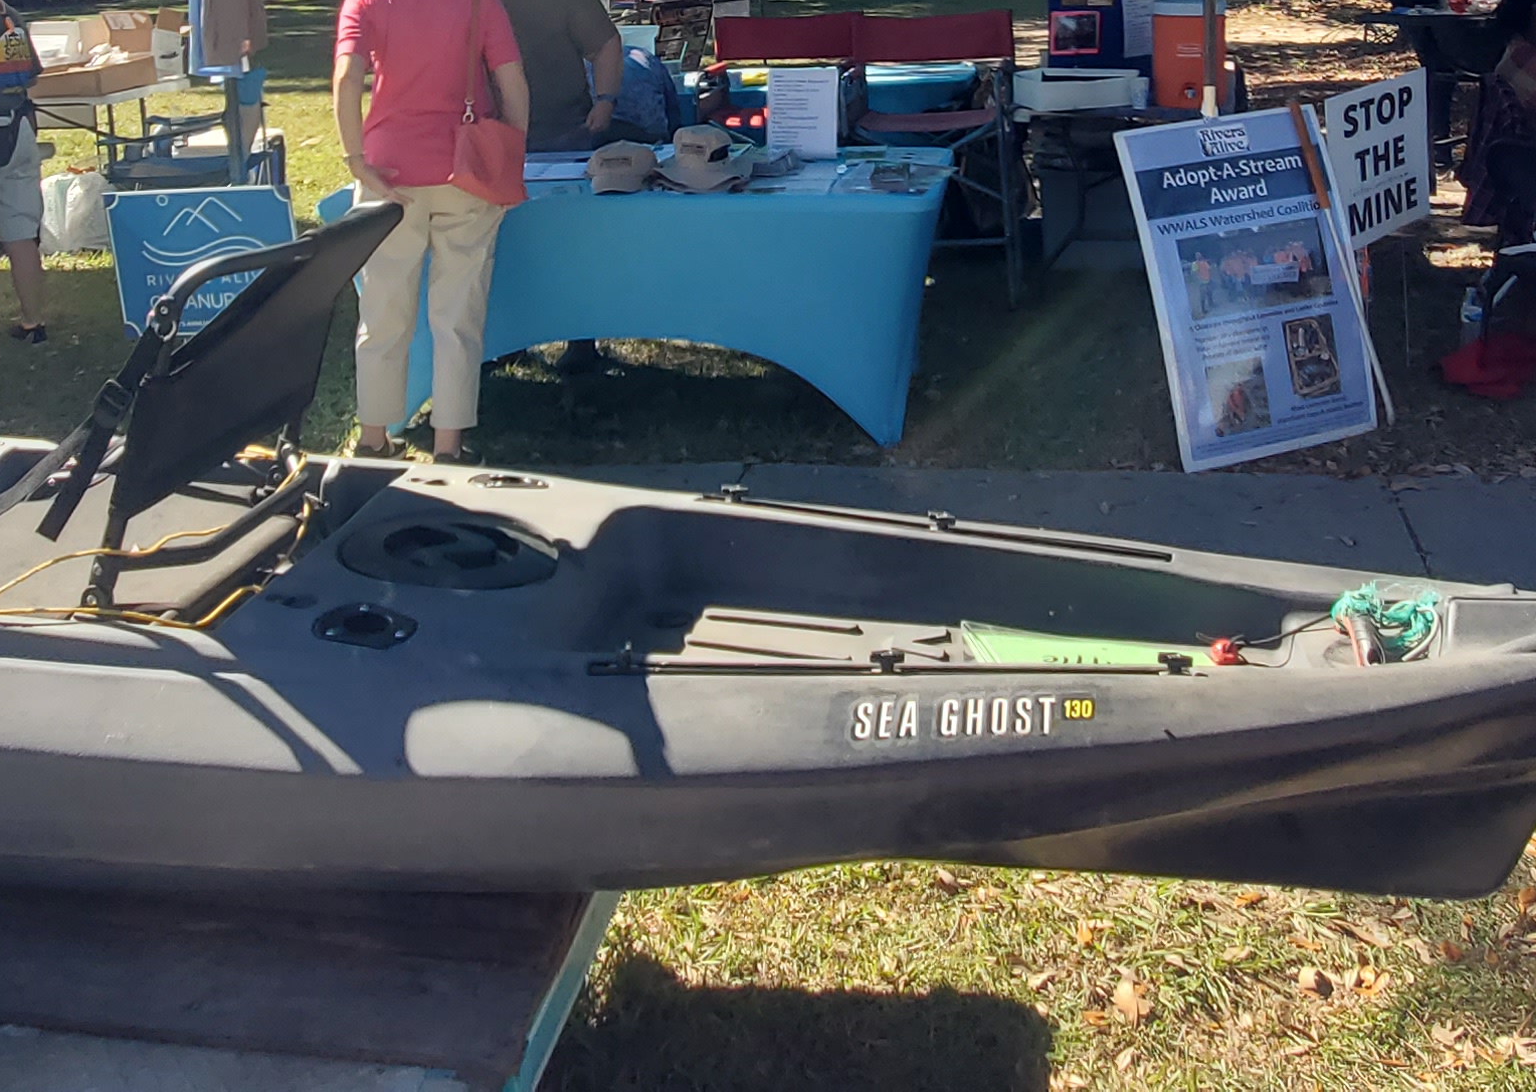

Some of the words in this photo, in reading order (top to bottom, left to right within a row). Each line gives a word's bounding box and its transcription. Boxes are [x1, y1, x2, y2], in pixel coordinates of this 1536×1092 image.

[1343, 85, 1413, 139] STOP
[1199, 127, 1246, 143] Rivers
[1209, 139, 1247, 156] Alive
[1162, 154, 1303, 189] Adopt-A-Stream
[1354, 133, 1406, 182] THE
[1210, 178, 1268, 204] Award
[1347, 176, 1419, 237] MINE
[1157, 217, 1208, 236] WWALS
[1208, 206, 1275, 227] Watershed
[1276, 200, 1321, 216] Coalitio
[854, 700, 917, 739] SEA
[940, 697, 1056, 737] GHOST
[1064, 699, 1093, 719] 130
